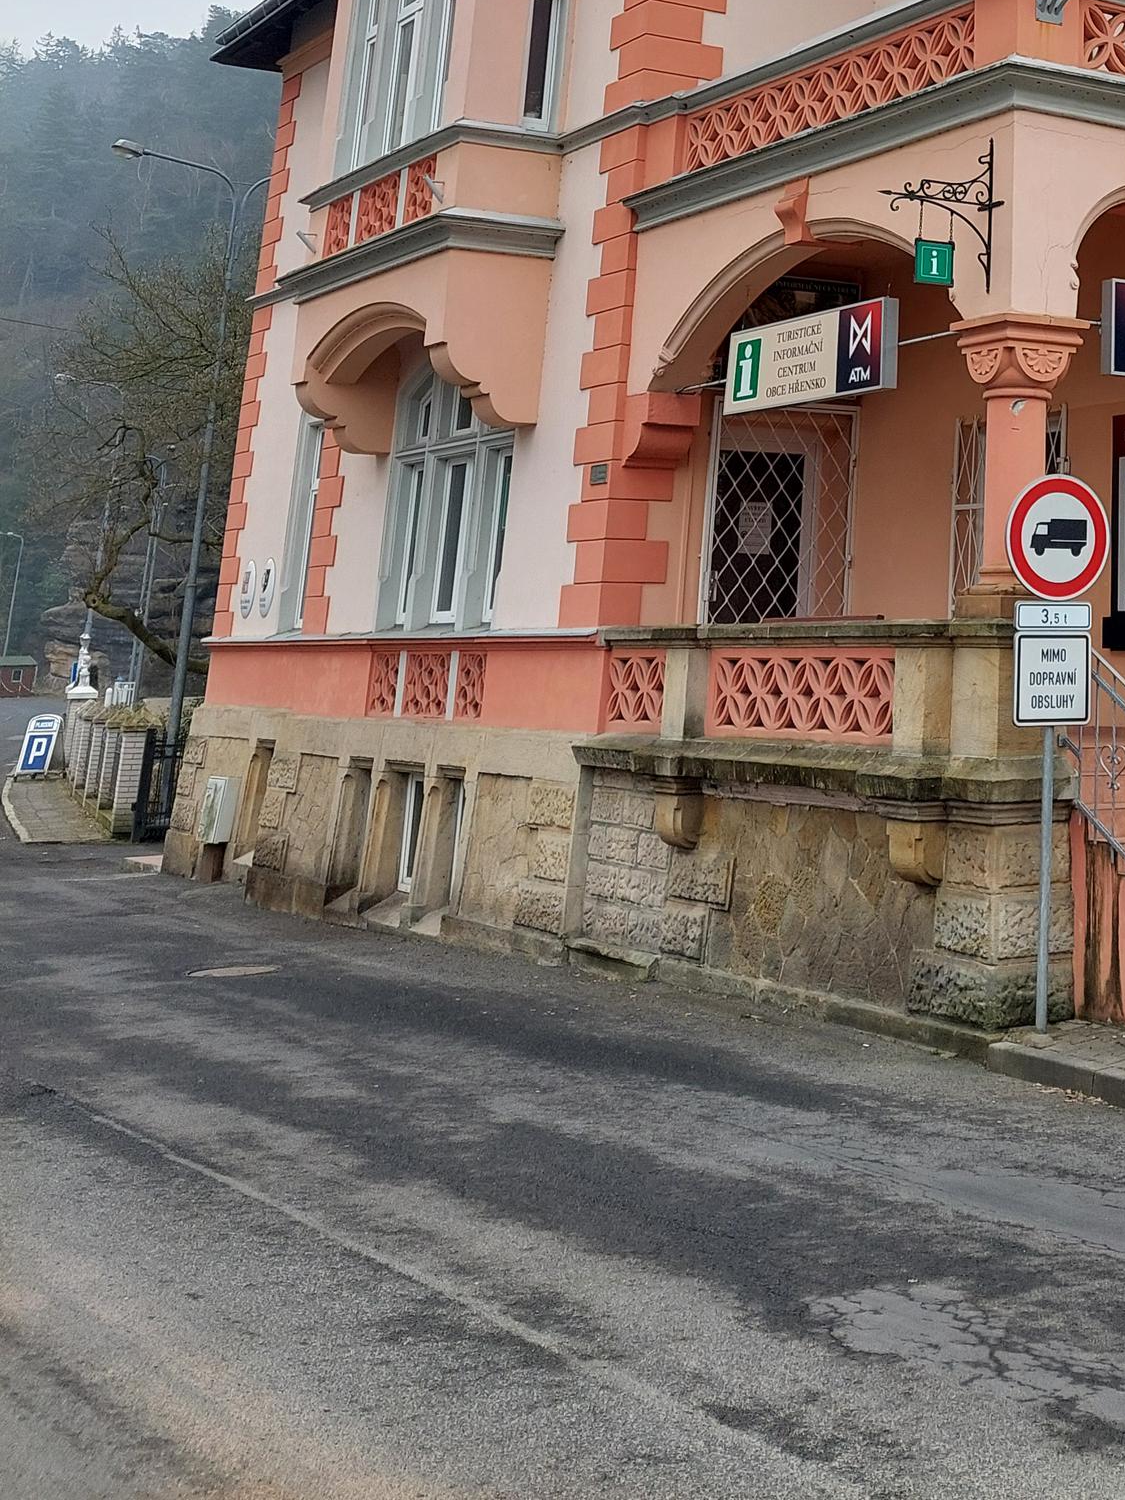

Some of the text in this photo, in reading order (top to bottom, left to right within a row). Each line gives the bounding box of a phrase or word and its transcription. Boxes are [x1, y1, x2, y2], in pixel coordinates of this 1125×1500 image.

[777, 320, 822, 344] TURISTICKÉ
[773, 338, 824, 362] INFORMAČNÍ
[777, 360, 816, 379] CENTRUM
[848, 365, 871, 384] ATM
[766, 376, 826, 398] OBCE HŘENSKO
[1041, 608, 1068, 626] 3,5 t
[1041, 648, 1067, 663] MIMO
[1029, 668, 1077, 686] DOPRAVNÍ
[1031, 694, 1075, 709] OBSLUHY
[28, 737, 48, 764] P
